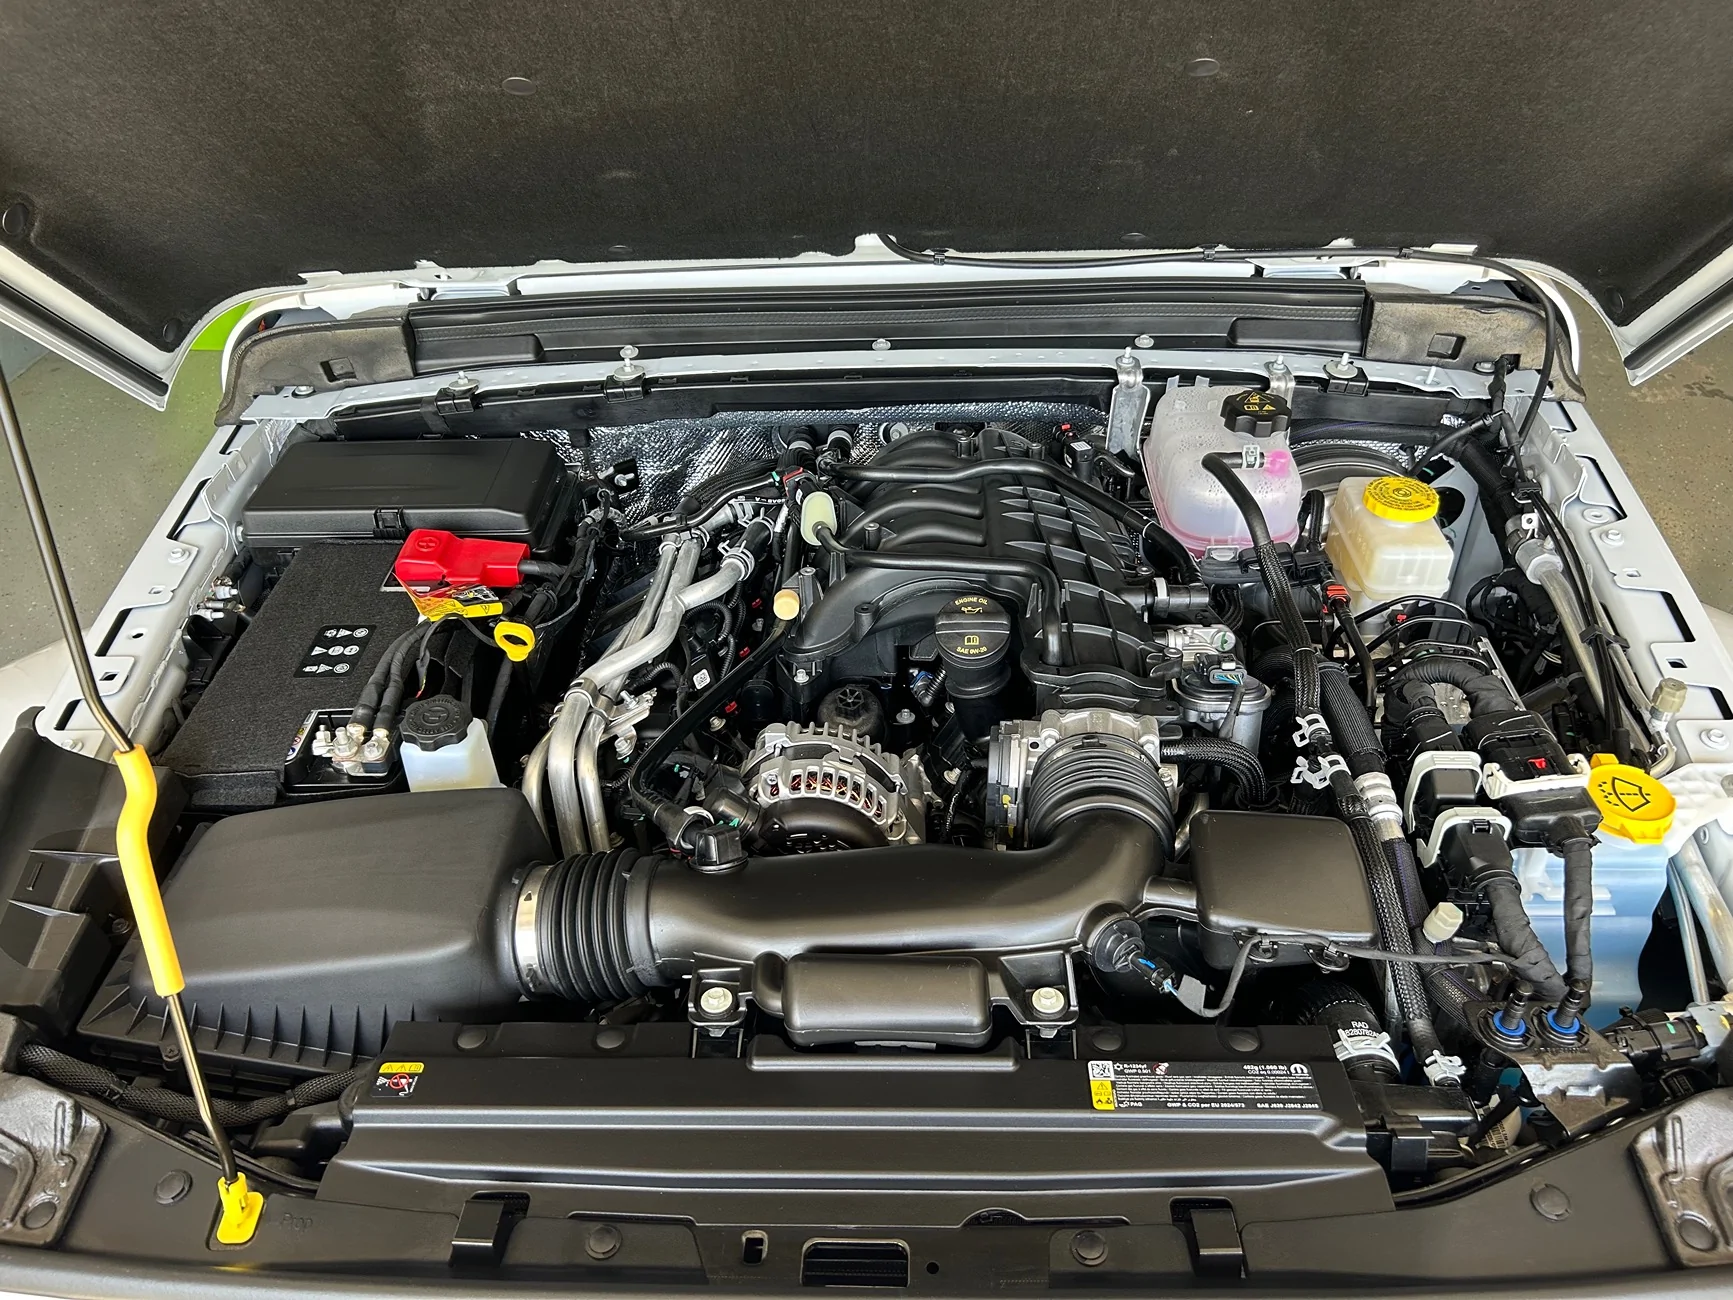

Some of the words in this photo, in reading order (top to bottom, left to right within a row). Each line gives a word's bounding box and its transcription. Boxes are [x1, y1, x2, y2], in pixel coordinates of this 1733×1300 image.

[954, 597, 977, 605] ENGINE
[978, 597, 988, 605] OIL
[956, 646, 969, 654] SAE
[969, 646, 987, 654] 0W-20
